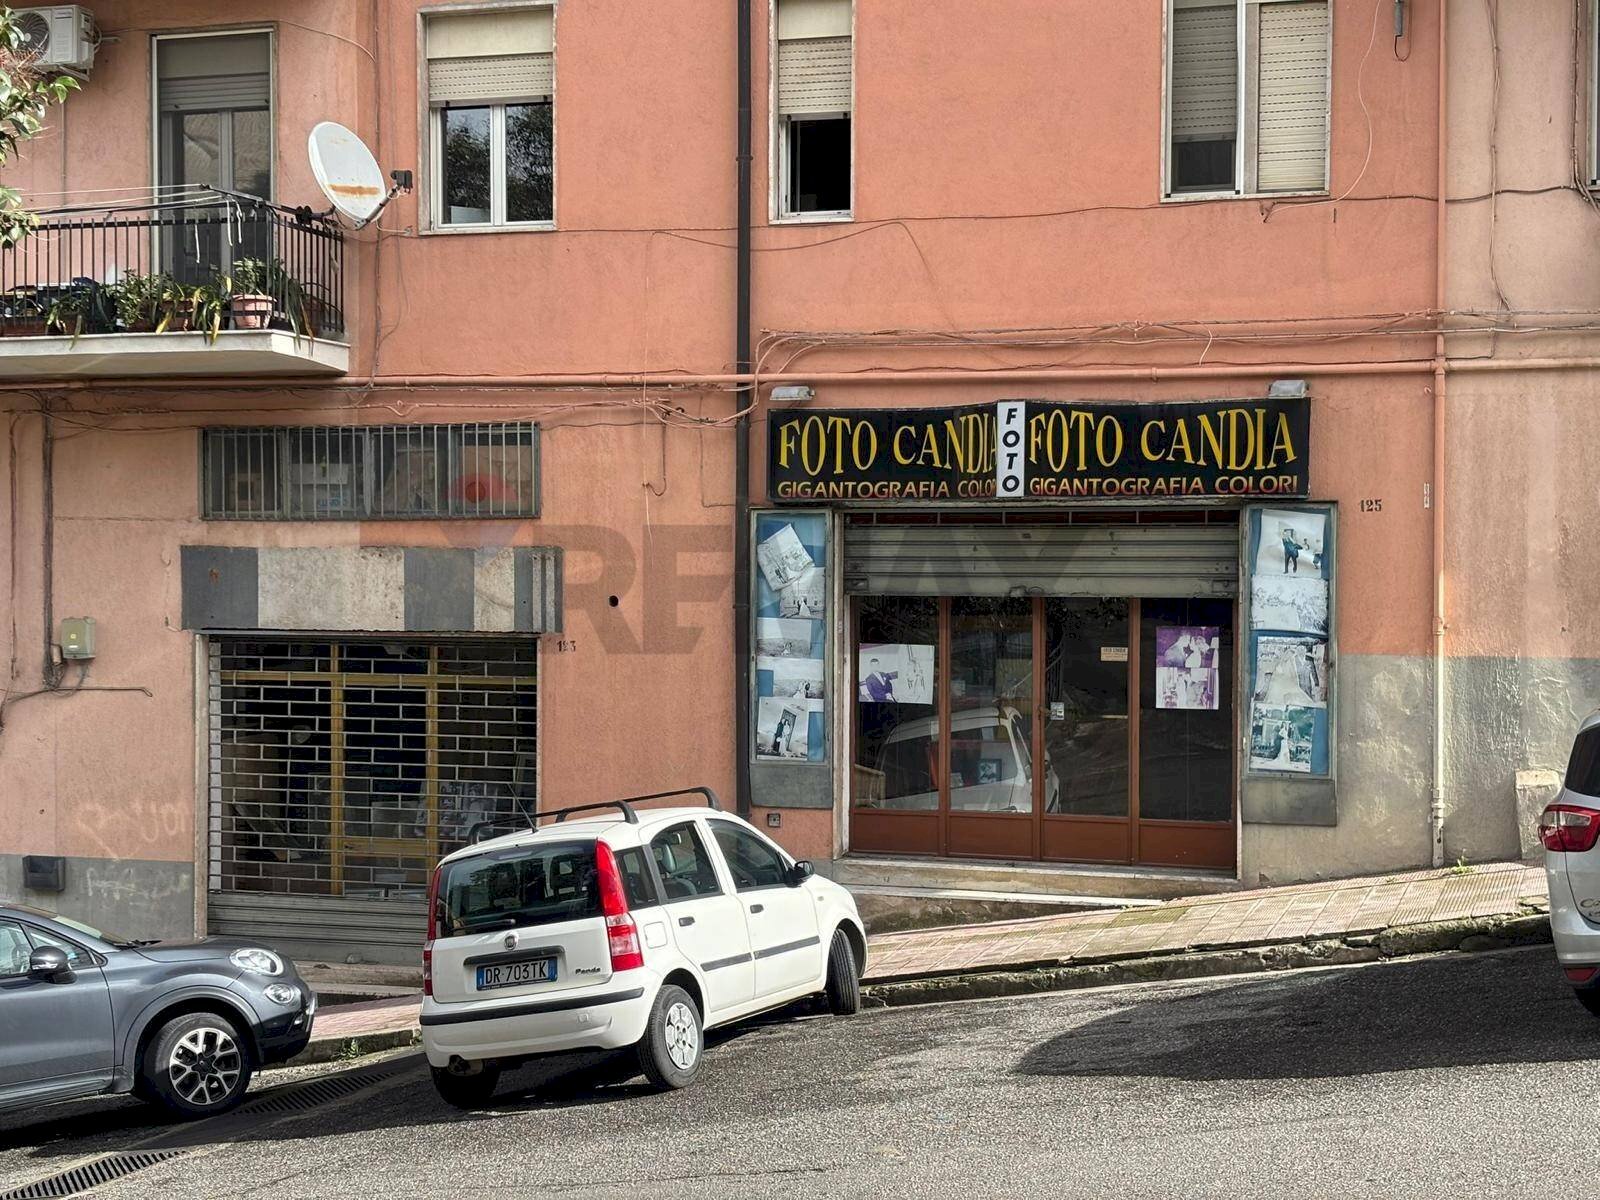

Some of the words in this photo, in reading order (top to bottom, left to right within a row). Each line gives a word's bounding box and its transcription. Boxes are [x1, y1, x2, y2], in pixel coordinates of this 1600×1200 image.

[779, 415, 878, 476] FOTO
[1002, 407, 1020, 492] FOTO
[1029, 409, 1123, 473] FOTO
[1140, 408, 1297, 470] CANDIA
[777, 480, 950, 498] GIGANTOGRAFIA
[1029, 477, 1202, 495] GIGANTOGRAFIA
[1215, 475, 1298, 494] COLORI
[1359, 498, 1383, 512] 125
[557, 640, 577, 652] 123
[485, 967, 501, 985] DR
[505, 961, 547, 982] 703TK
[575, 966, 601, 975] Panda
